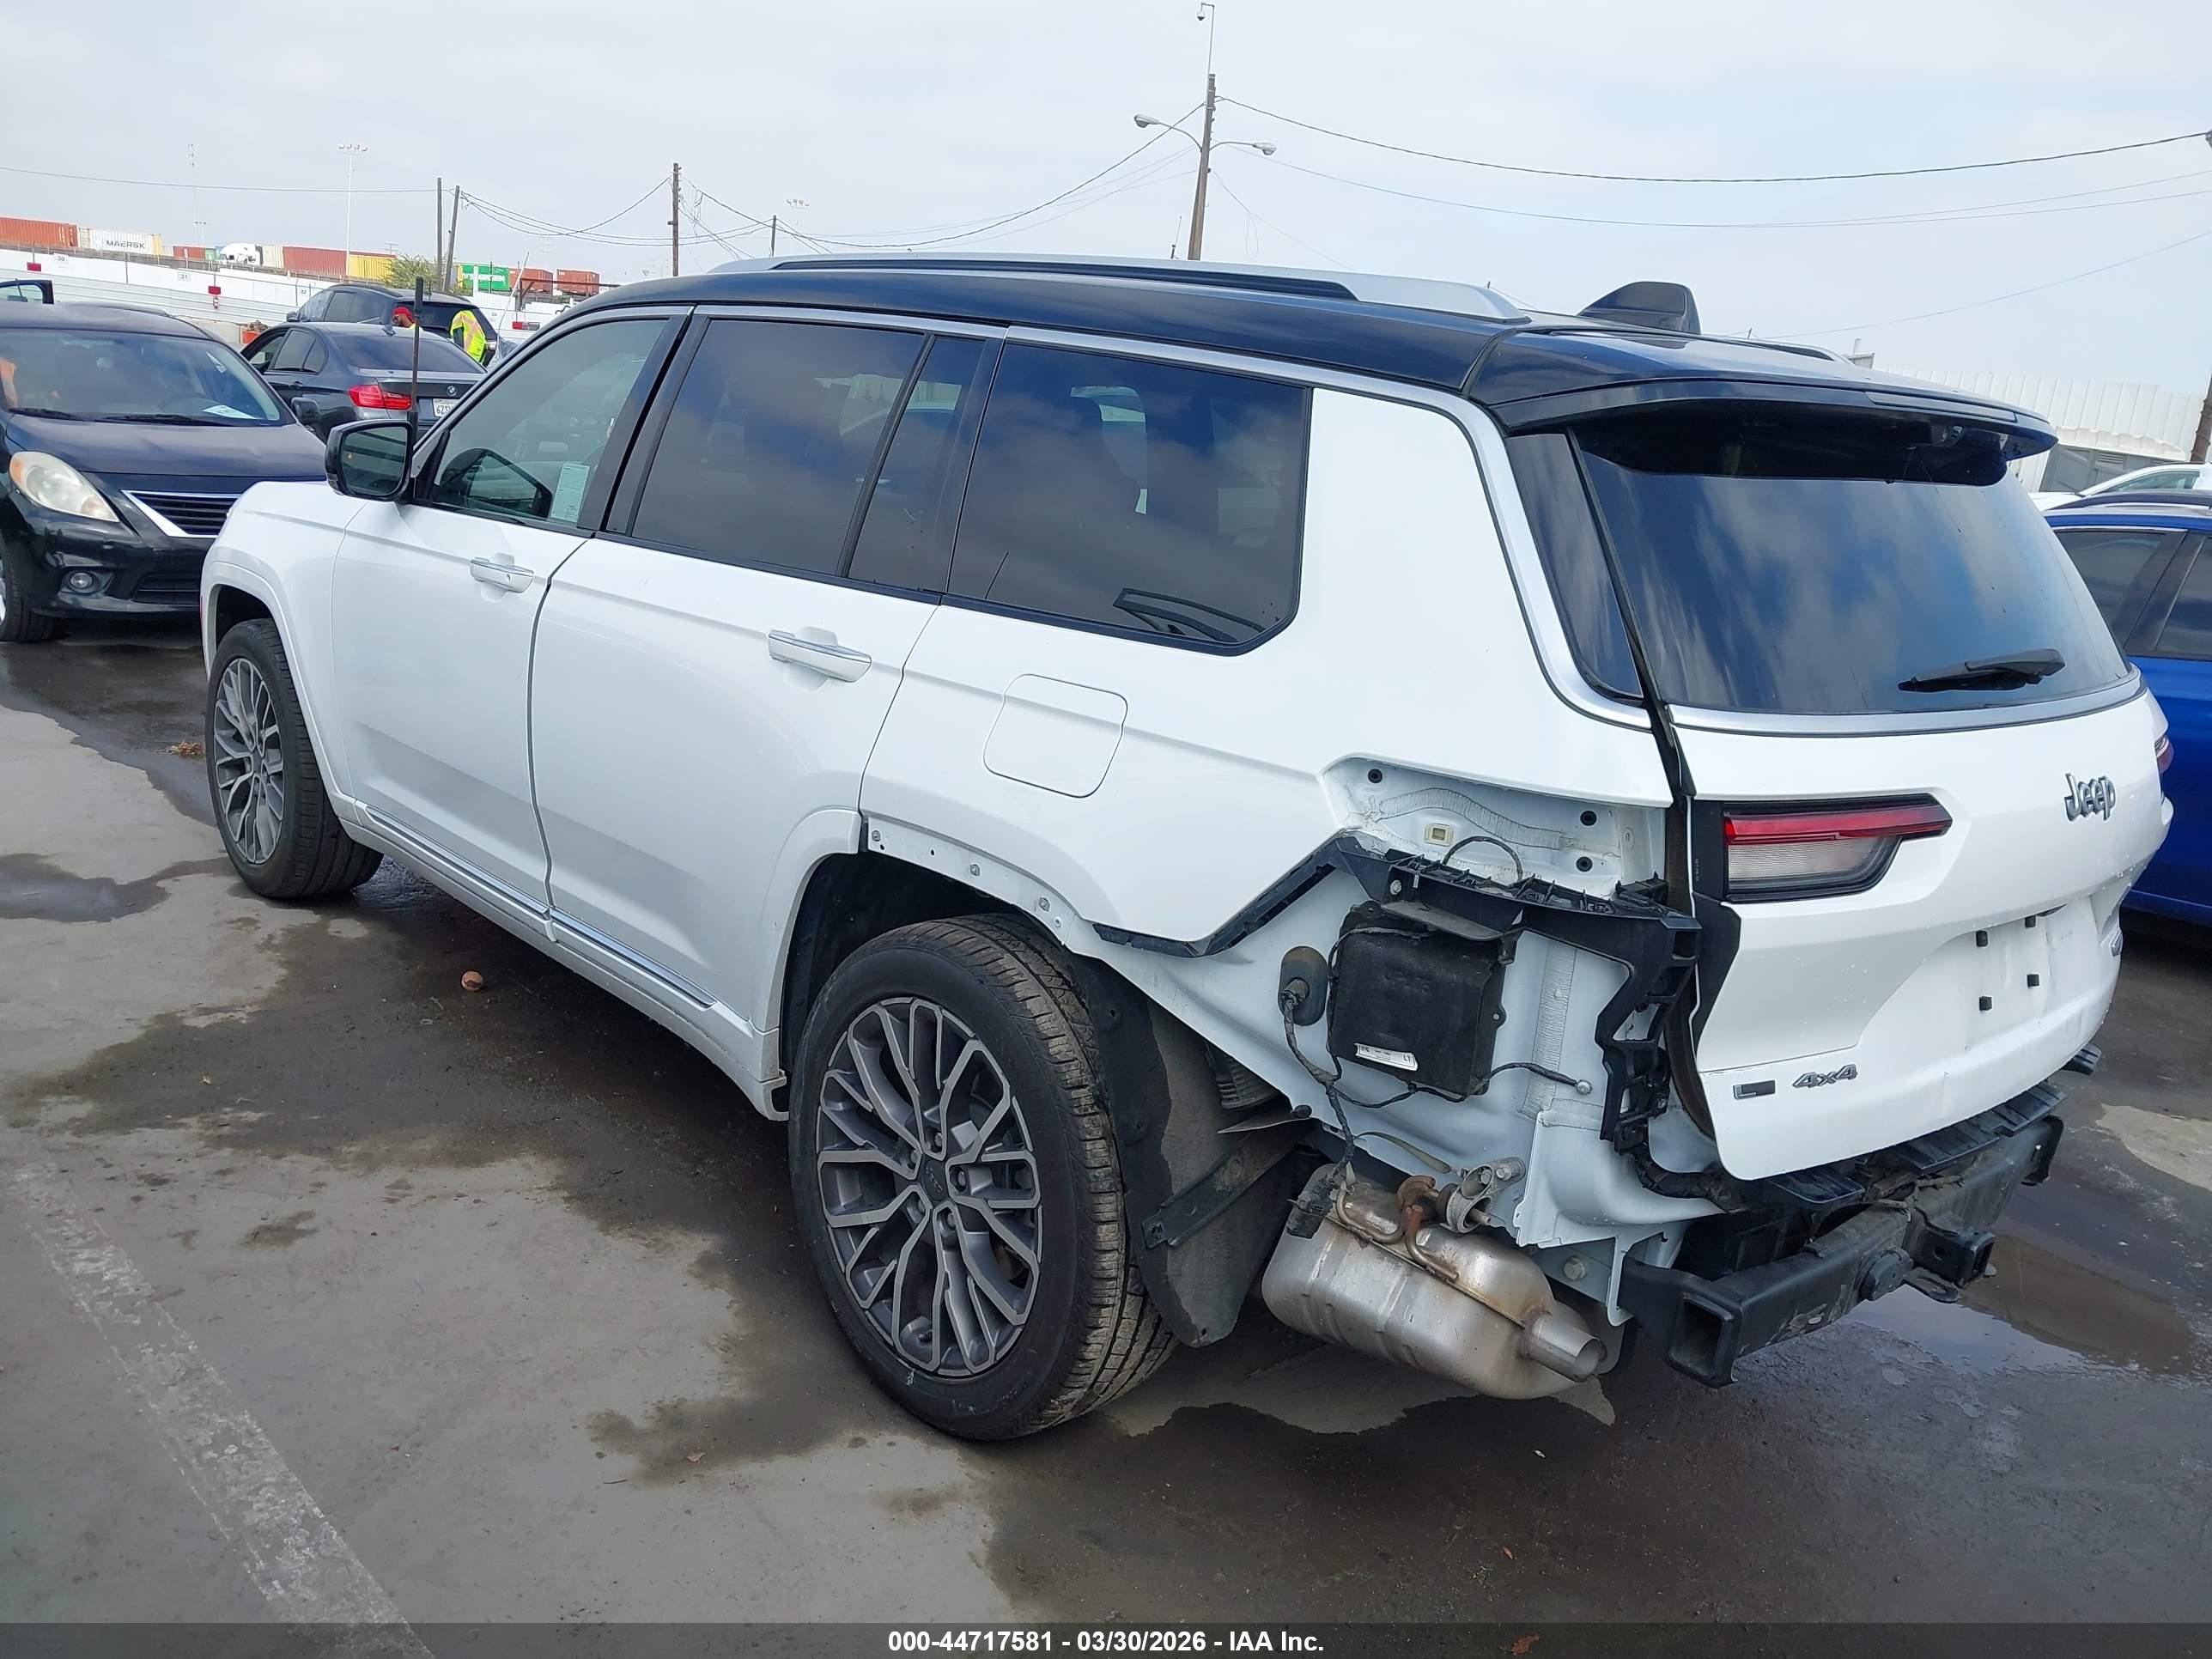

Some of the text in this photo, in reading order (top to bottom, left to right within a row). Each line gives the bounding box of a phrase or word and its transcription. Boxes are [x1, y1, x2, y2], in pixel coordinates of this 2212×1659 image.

[106, 240, 145, 249] MAERSK
[2063, 773, 2117, 822] Jeep
[1791, 1063, 1859, 1089] 4x4
